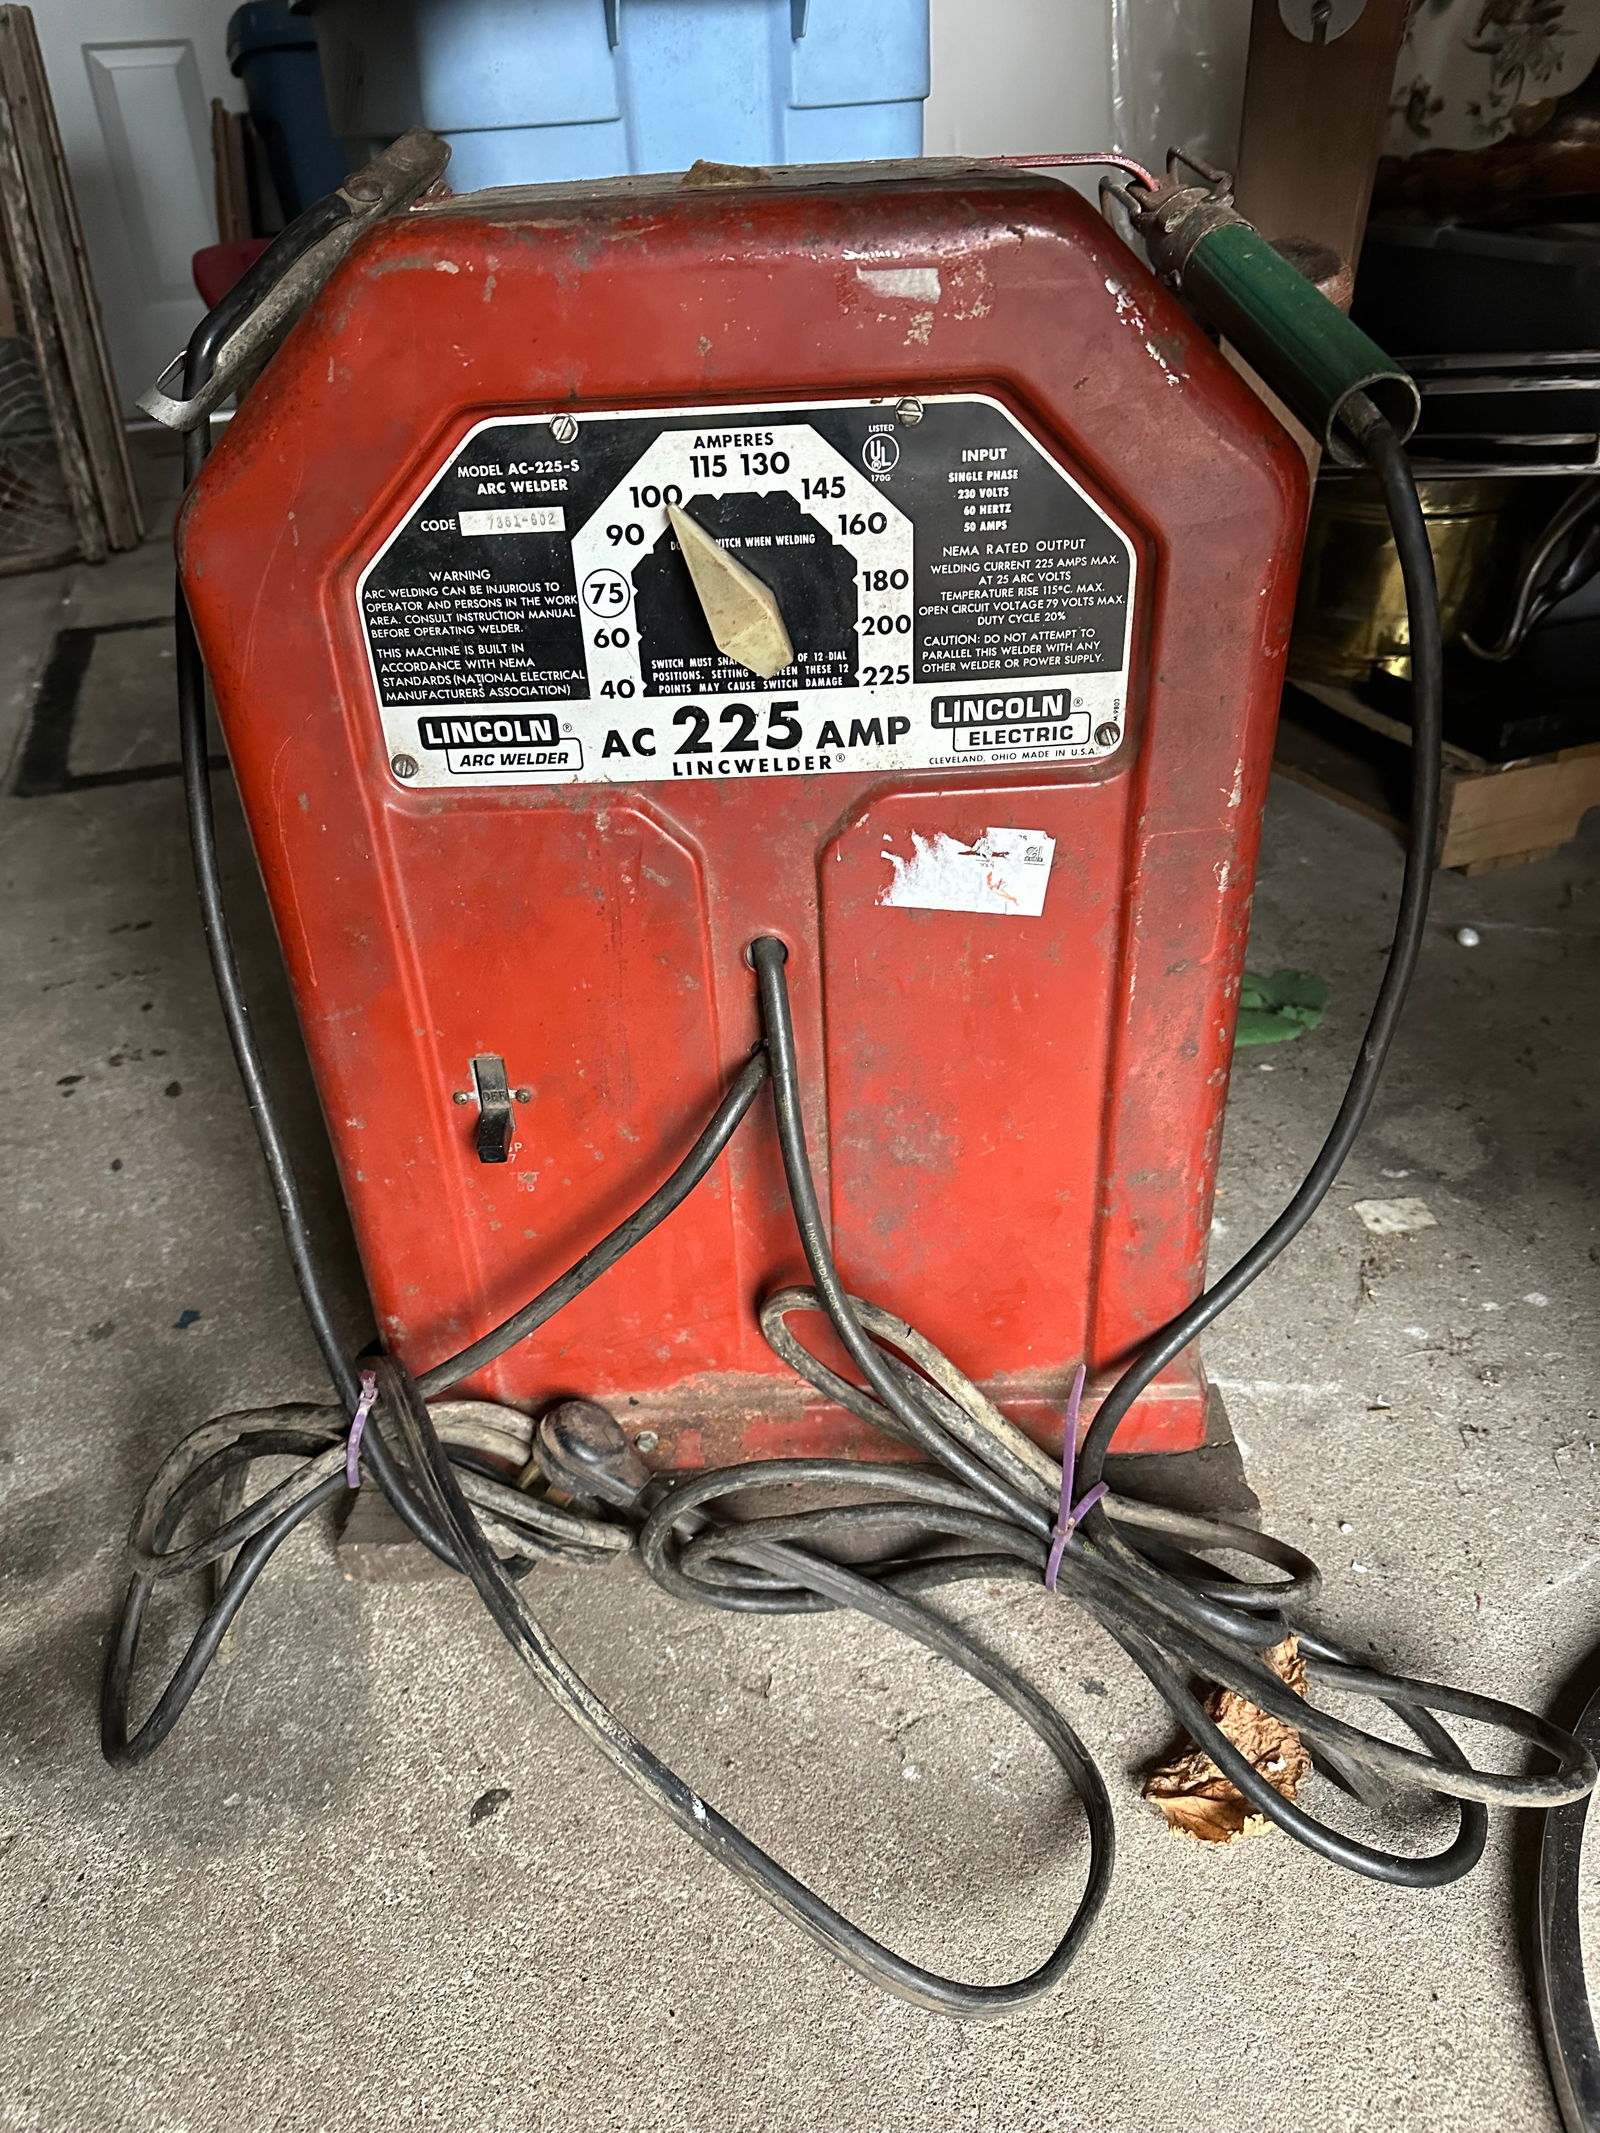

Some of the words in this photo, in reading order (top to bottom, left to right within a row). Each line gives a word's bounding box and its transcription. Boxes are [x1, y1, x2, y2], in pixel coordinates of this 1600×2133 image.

[869, 424, 894, 432] LISTED
[693, 432, 774, 449] AMPERES
[870, 440, 891, 466] UL
[962, 448, 1007, 462] INPUT
[458, 465, 503, 477] MODEL
[508, 460, 580, 475] AC-225-S
[689, 455, 728, 477] 115
[740, 452, 790, 475] 130
[871, 474, 891, 482] 170G
[948, 472, 983, 483] SINGLE
[987, 470, 1018, 481] PHASE
[477, 482, 506, 495] ARC
[510, 479, 568, 493] WELDER
[802, 476, 846, 500] 145
[958, 489, 976, 499] 230
[979, 487, 1009, 498] VOLTS
[630, 484, 682, 508] 100
[964, 505, 976, 515] 60
[980, 504, 1011, 514] HERTZ
[421, 519, 456, 531] CODE
[838, 512, 887, 536] 160
[964, 522, 976, 532] 50
[980, 520, 1007, 531] AMPS
[606, 524, 645, 546] 90
[746, 536, 771, 546] WHEN
[775, 534, 815, 545] WELDING
[943, 546, 979, 557] NEMA
[986, 542, 1028, 554] RATED
[1036, 539, 1086, 552] OUTPUT
[931, 563, 980, 574] WELDING
[984, 560, 1031, 571] CURRENT
[1035, 559, 1053, 569] 225
[1057, 557, 1087, 567] AMPS
[1091, 555, 1119, 565] MAX.
[429, 570, 490, 582] WARNING
[862, 570, 909, 591] 180
[979, 576, 993, 585] AT
[997, 575, 1009, 584] 25
[1012, 573, 1034, 583] ARC
[1038, 571, 1071, 582] VOLTS
[365, 590, 385, 599] ARC
[389, 587, 438, 598] WELDING
[442, 586, 466, 595] CAN
[470, 585, 483, 595] BE
[486, 582, 541, 594] INJURIOUS
[545, 582, 559, 591] TO
[589, 583, 624, 605] 75
[941, 588, 1014, 601] TEMPERATURE
[1018, 587, 1039, 596] RISE
[1077, 583, 1105, 593] MAX.
[367, 602, 423, 612] OPERATOR
[427, 601, 450, 610] AND
[455, 598, 501, 609] PERSONS
[506, 598, 517, 606] IN
[520, 597, 541, 606] THE
[545, 595, 577, 605] WORK
[919, 606, 948, 616] OPEN
[952, 603, 989, 614] CIRCUIT
[993, 600, 1043, 611] VOLTAGE
[1046, 599, 1057, 608] 79
[1061, 597, 1094, 607] VOLTS
[1097, 595, 1125, 605] MAX.
[370, 616, 401, 625] AREA.
[405, 614, 452, 624] CONSULT
[457, 610, 524, 622] INSTRUCTION
[528, 609, 576, 619] MANUAL
[861, 615, 911, 636] 200
[978, 615, 1005, 626] DUTY
[1008, 613, 1040, 623] CYCLE
[1044, 611, 1066, 621] 20%
[371, 628, 410, 638] BEFORE
[414, 626, 474, 636] OPERATING
[478, 625, 523, 634] WELDER.
[594, 628, 630, 648] 60
[924, 634, 980, 647] CAUTION:
[984, 635, 1000, 643] DO
[1004, 632, 1027, 642] NOT
[1030, 629, 1076, 641] ATTEMPT
[1081, 628, 1095, 638] TO
[377, 649, 401, 658] THIS
[405, 646, 460, 657] MACHINE
[465, 646, 474, 655] IS
[478, 644, 507, 654] BUILT
[512, 644, 524, 653] IN
[923, 649, 972, 660] PARALLEL
[976, 648, 997, 657] THIS
[1001, 645, 1042, 655] WELDER
[1046, 643, 1072, 653] WITH
[1076, 641, 1100, 651] ANY
[381, 661, 461, 673] ACCORDANCE
[465, 659, 495, 669] WITH
[499, 658, 535, 667] NEMA
[652, 659, 684, 669] SWITCH
[690, 658, 712, 667] MUST
[798, 653, 808, 662] OF
[814, 653, 823, 661] 12
[829, 651, 847, 661] DIAL
[922, 663, 956, 673] OTHER
[960, 661, 1000, 671] WELDER
[1005, 659, 1019, 668] OR
[1023, 656, 1061, 667] POWER
[1065, 654, 1104, 665] SUPPLY.
[383, 676, 451, 687] STANDARDS
[454, 673, 518, 685] (NATIONAL
[521, 670, 585, 681] ELECTRICAL
[653, 671, 704, 681] POSITIONS.
[712, 668, 749, 678] SETTING
[805, 665, 831, 674] THESE
[839, 664, 849, 673] 12
[862, 665, 910, 685] 225
[386, 688, 485, 701] MANUFACTURERS
[489, 685, 570, 697] ASSOCIATION)
[600, 680, 635, 699] 40
[659, 684, 691, 694] POINTS
[699, 683, 719, 692] MAY
[728, 681, 755, 691] CAUSE
[764, 679, 798, 689] SWITCH
[806, 677, 842, 687] DAMAGE
[938, 694, 1064, 723] LINCOLN
[424, 719, 553, 744] LINCOLN
[602, 728, 656, 758] AC
[673, 701, 802, 755] 225
[816, 717, 911, 749] AMP
[969, 726, 1073, 746] ELECTRIC
[460, 754, 496, 767] ARC
[500, 752, 569, 765] WELDER
[991, 753, 1016, 761] OHIO
[1022, 751, 1049, 759] MADE
[673, 756, 832, 776] LINCWELDER
[483, 1090, 505, 1101] OFF
